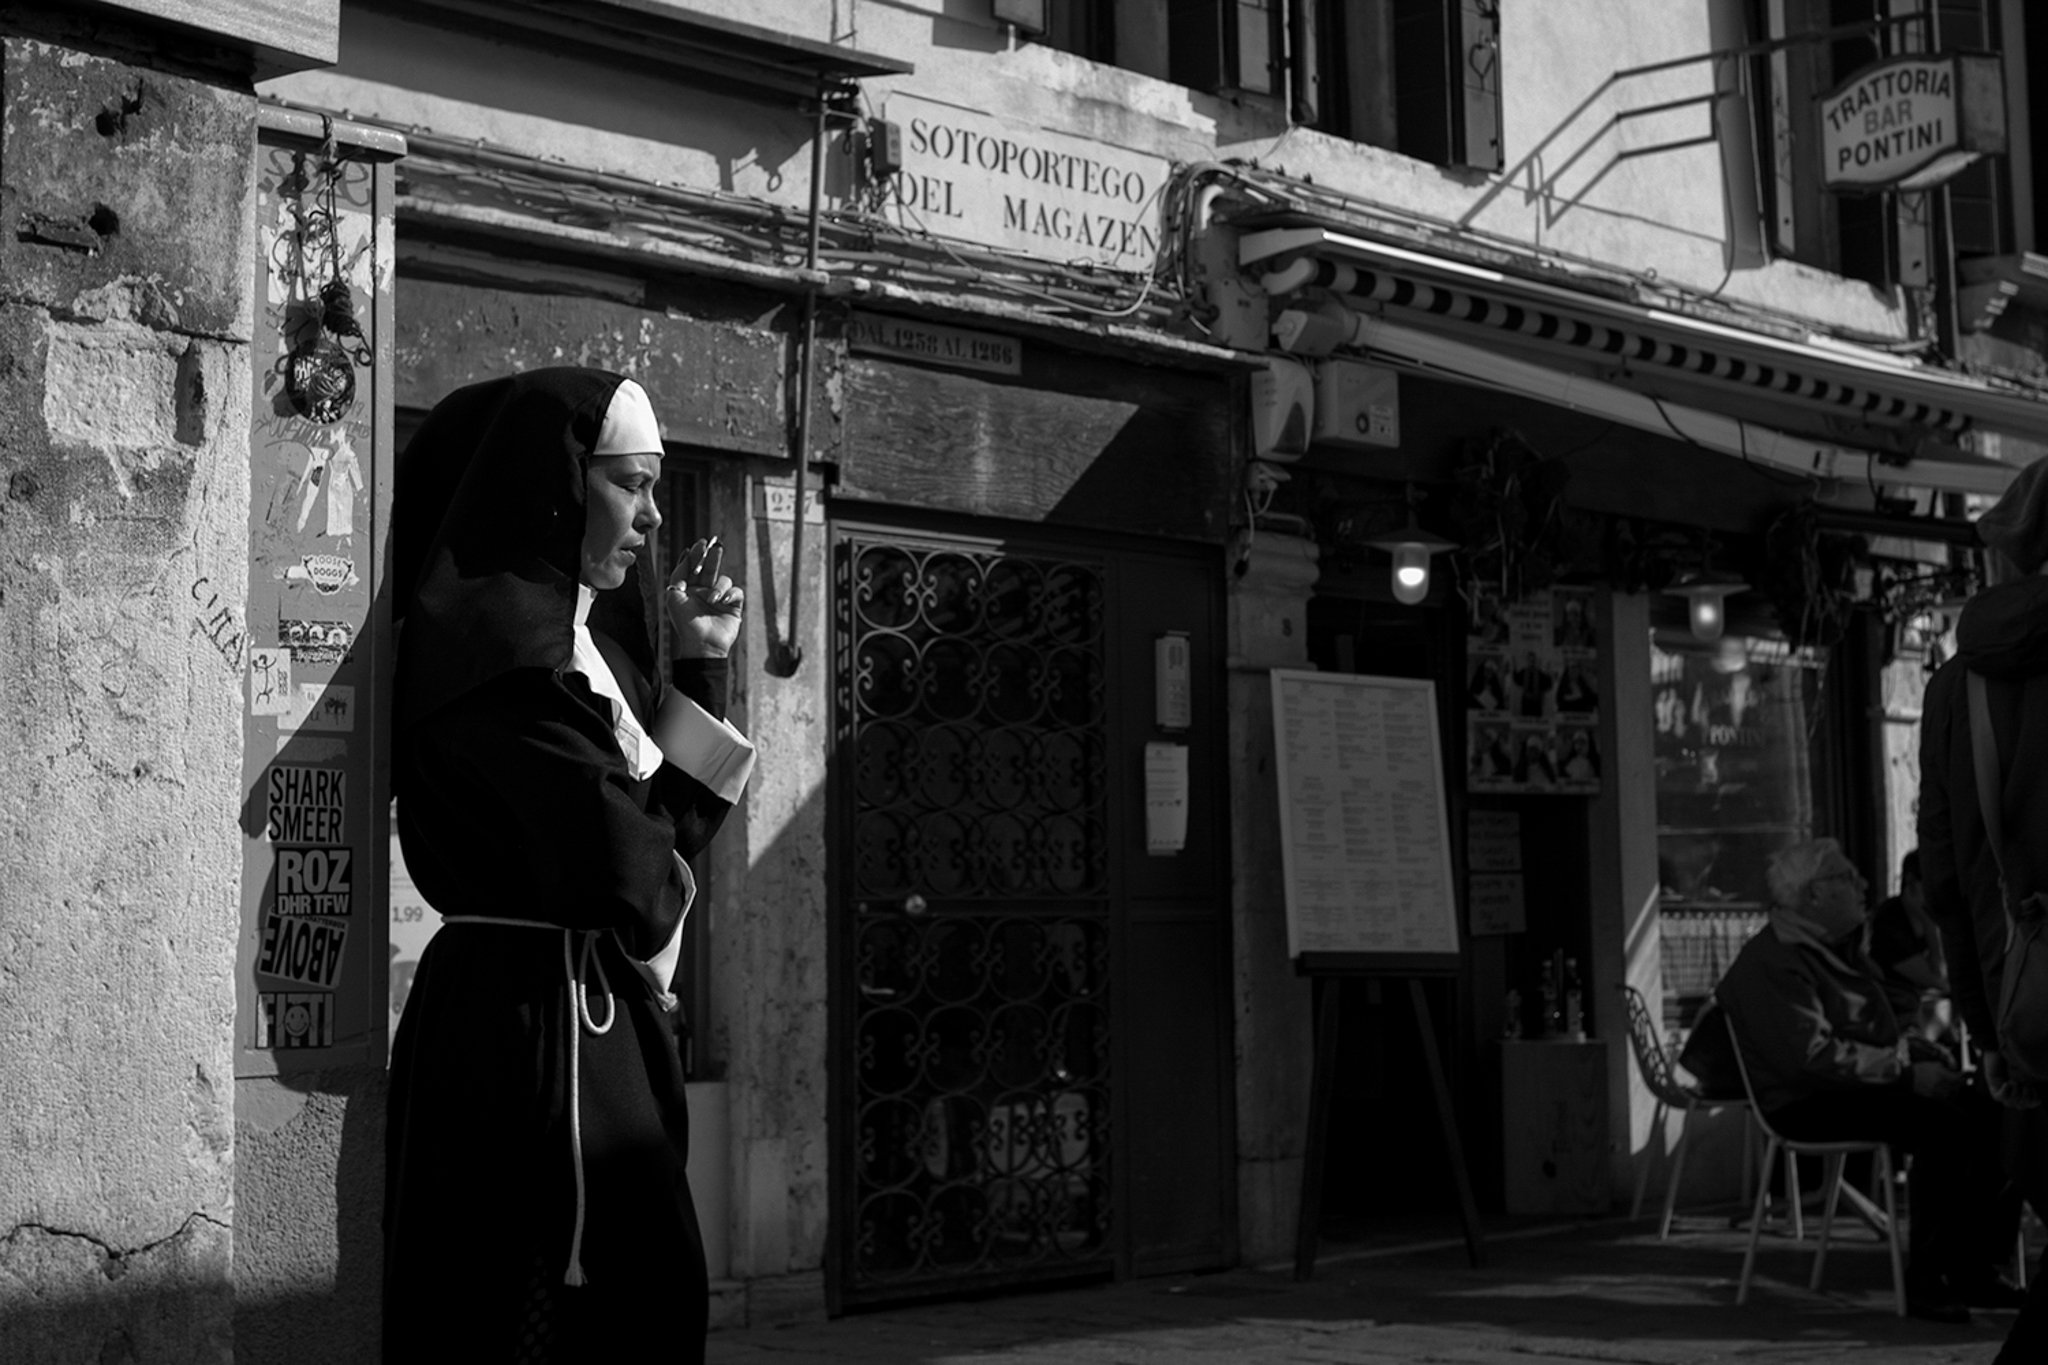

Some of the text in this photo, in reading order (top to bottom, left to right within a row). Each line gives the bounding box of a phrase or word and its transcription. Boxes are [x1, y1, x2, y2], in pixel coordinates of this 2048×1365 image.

[1827, 68, 1951, 132] TRATTORIA
[1864, 100, 1913, 135] BAR
[910, 117, 1145, 205] SOTOPORTEGO
[1838, 118, 1942, 173] PONTINI
[896, 170, 1158, 259] DEL MAGAZEN
[314, 567, 343, 579] DOGGS
[269, 768, 343, 807] SHARK
[268, 805, 342, 842] SMEER
[278, 848, 351, 894] ROZ
[278, 894, 350, 915] DHR TFW
[260, 915, 345, 985] ABOVE
